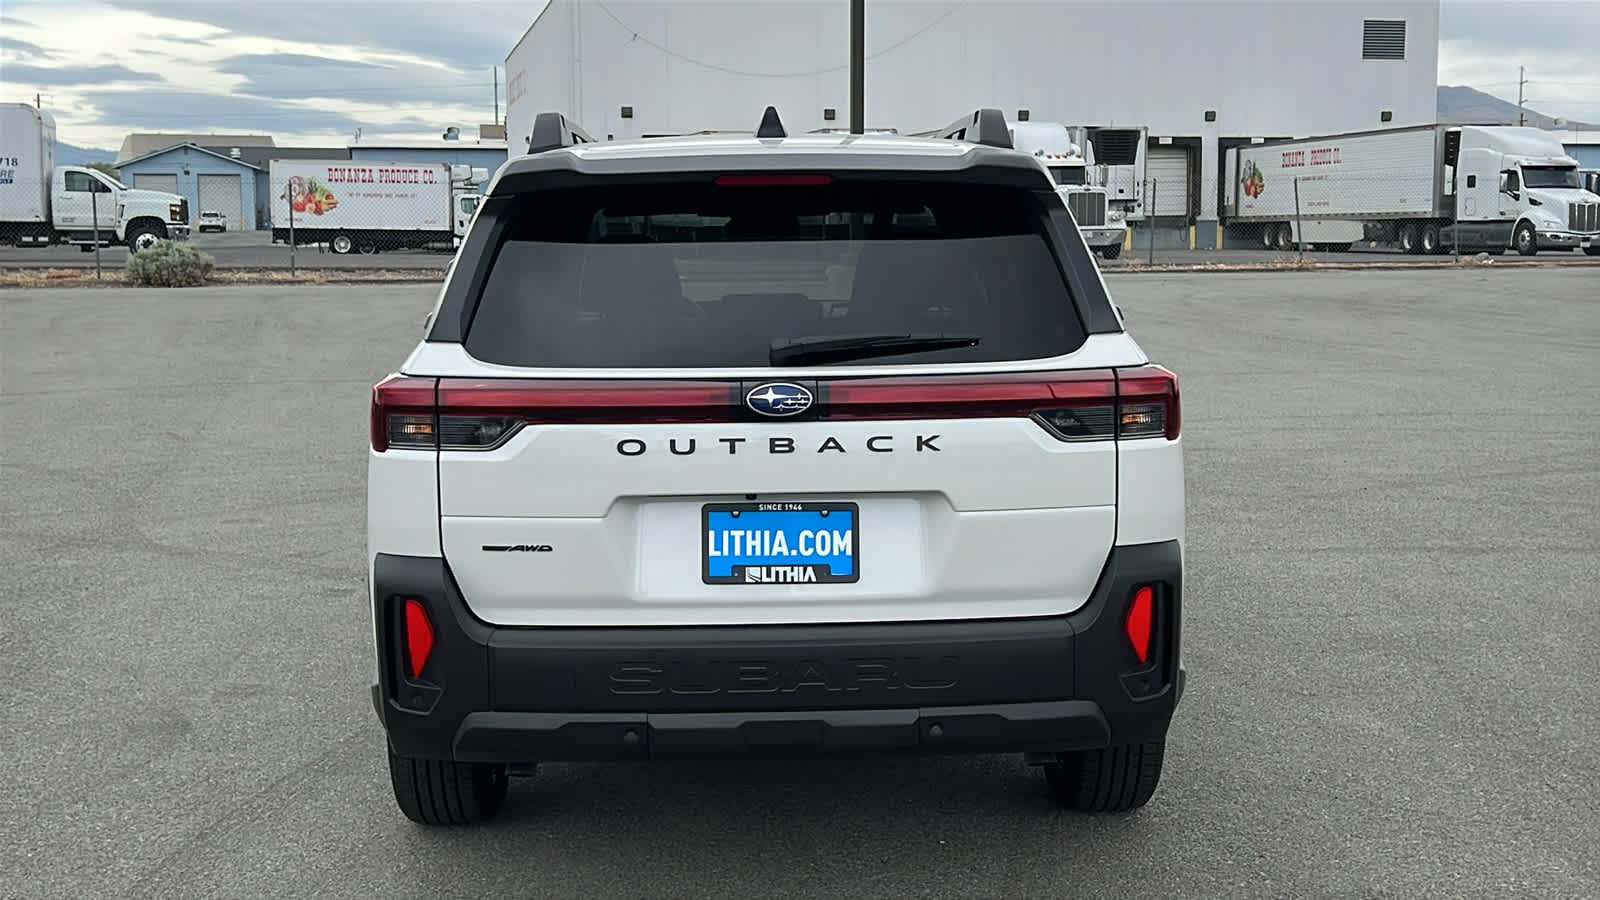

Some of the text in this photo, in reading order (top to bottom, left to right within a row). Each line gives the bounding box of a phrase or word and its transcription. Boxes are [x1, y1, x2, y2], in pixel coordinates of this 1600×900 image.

[327, 167, 438, 184] BONANZA PRODUCE CO.
[616, 434, 942, 457] OUTBACK
[758, 503, 802, 511] SINCE 1946
[507, 544, 553, 552] AWD
[708, 529, 852, 557] LITHIA.COM
[761, 566, 817, 583] LITHIA
[608, 656, 959, 695] SUBARU
